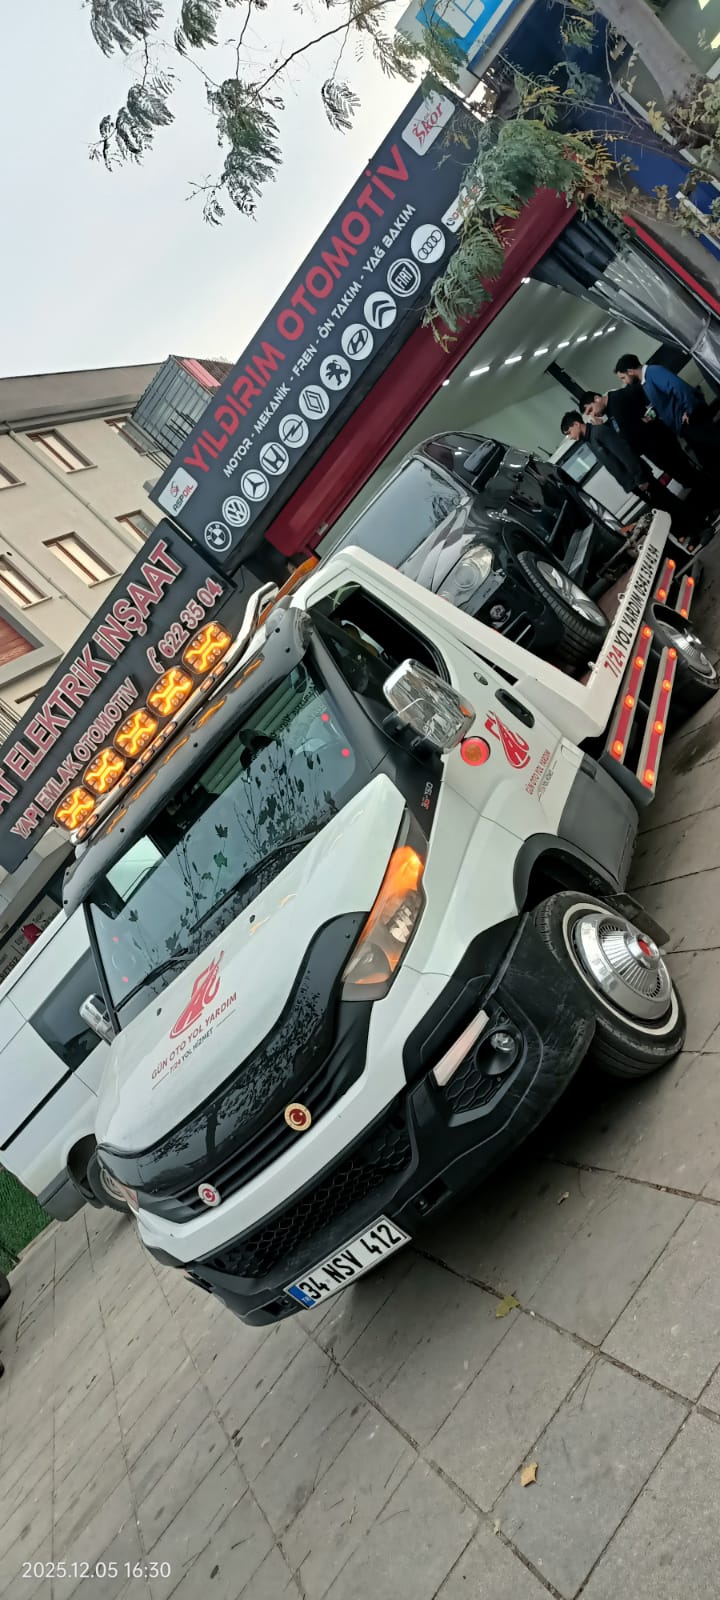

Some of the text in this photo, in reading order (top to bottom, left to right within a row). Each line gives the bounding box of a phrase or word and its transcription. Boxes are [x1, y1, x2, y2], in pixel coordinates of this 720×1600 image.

[184, 144, 408, 473] YILDIRIM OTOMOTİV
[223, 204, 416, 477] MOTOR MEKANİK FREN ÖN TAKIM YAĞ BAKIM
[614, 627, 632, 650] YOL
[622, 591, 642, 630] YARDIM
[4, 643, 112, 781] ELEKTRİK
[93, 540, 182, 660] İNŞAAT
[604, 645, 625, 678] 7/24
[10, 577, 224, 840] YAPI EMLAK OTOMOTİV 622 35 04
[152, 992, 236, 1079] GÜN OTO YOL YARDIM
[299, 1224, 402, 1300] 34 NSV 412
